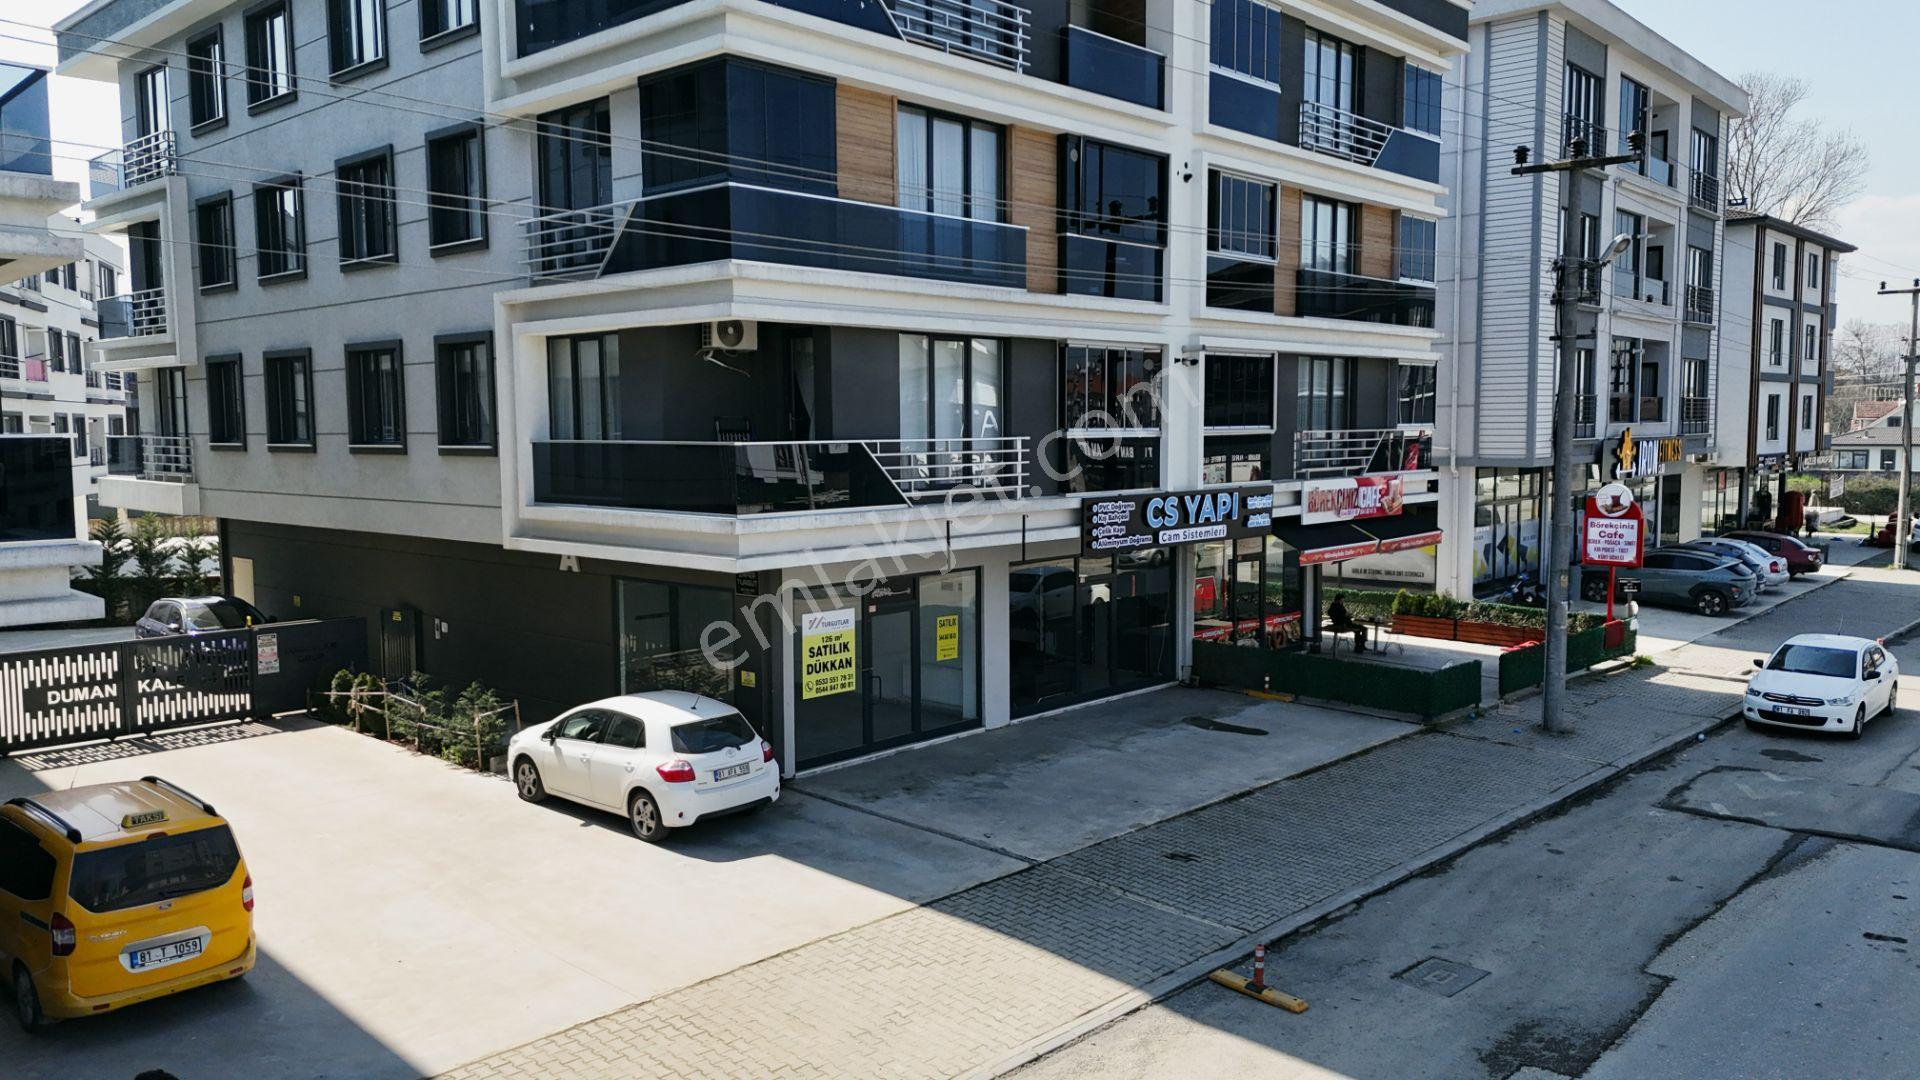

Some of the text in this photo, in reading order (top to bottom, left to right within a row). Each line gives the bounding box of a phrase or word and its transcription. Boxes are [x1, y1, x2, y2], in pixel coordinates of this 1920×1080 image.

[1638, 440, 1658, 476] IRON
[1360, 486, 1381, 508] CAFE
[1110, 501, 1135, 512] Doğrama
[1147, 496, 1178, 528] CS
[1184, 492, 1239, 524] YAPI
[1161, 526, 1225, 542] Cam Sistemleri
[1599, 530, 1624, 539] Cafe
[560, 554, 580, 572] A
[821, 619, 850, 628] TURGUTLAR
[821, 635, 833, 643] 126
[808, 641, 850, 658] SATILIK
[806, 657, 852, 675] DÜKKAN
[47, 684, 117, 705] DUMAN
[140, 951, 151, 963] 81
[161, 946, 166, 957] T
[174, 940, 198, 955] 1059
